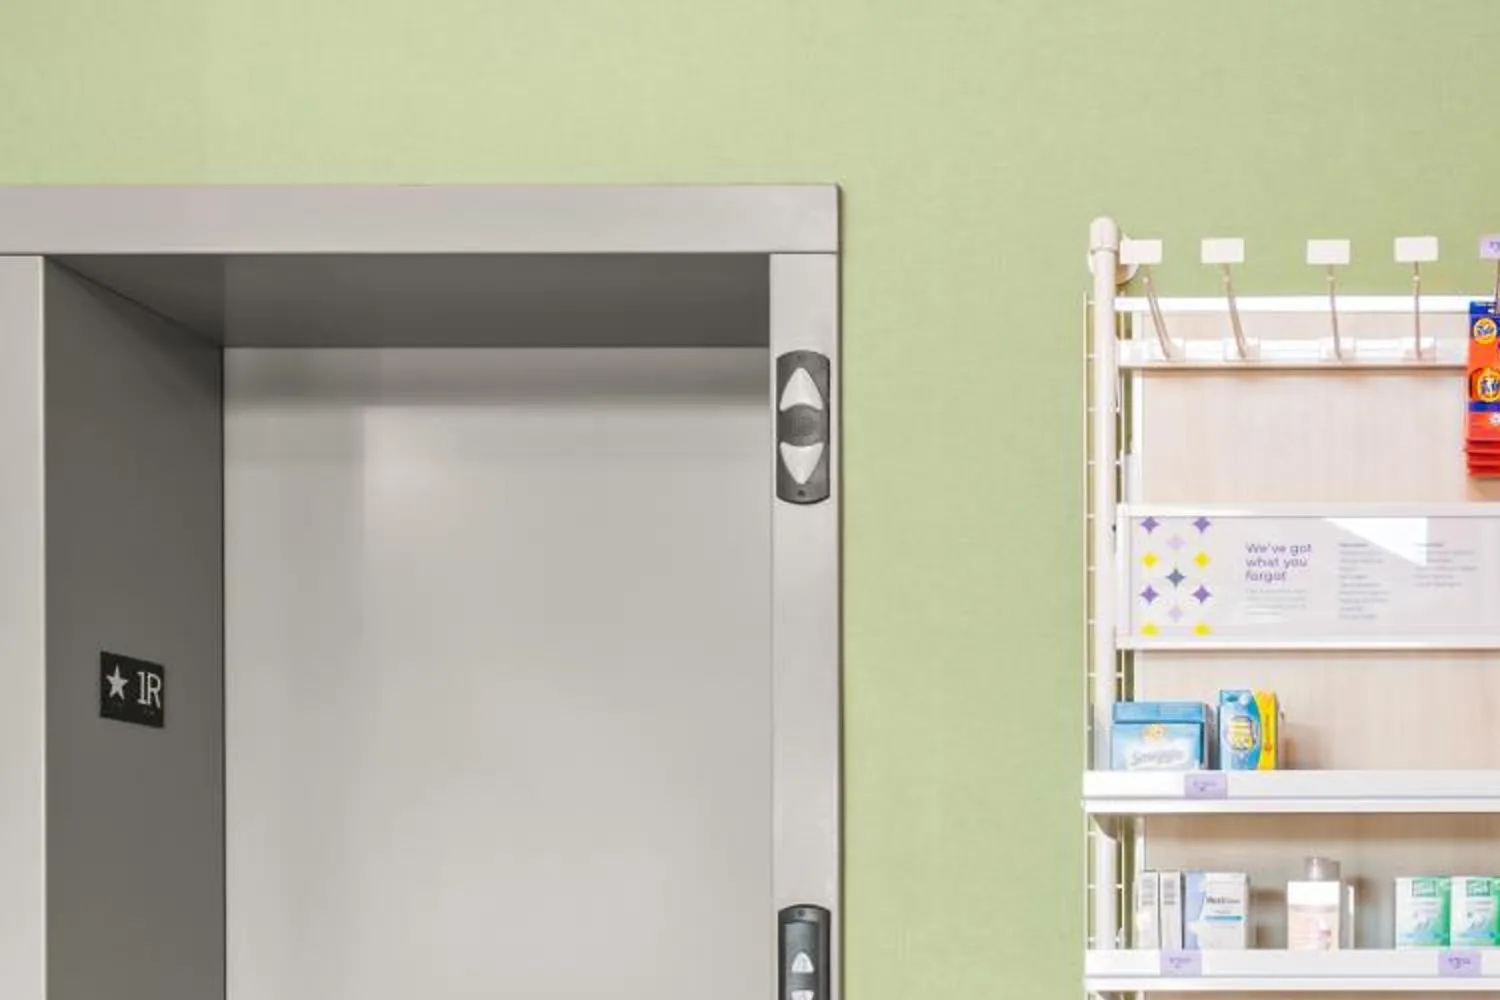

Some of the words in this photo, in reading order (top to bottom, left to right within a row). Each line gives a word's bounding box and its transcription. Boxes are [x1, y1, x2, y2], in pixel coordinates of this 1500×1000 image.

[1290, 544, 1312, 557] got
[1245, 557, 1279, 568] what
[1283, 558, 1308, 569] you
[1245, 570, 1287, 583] forgot
